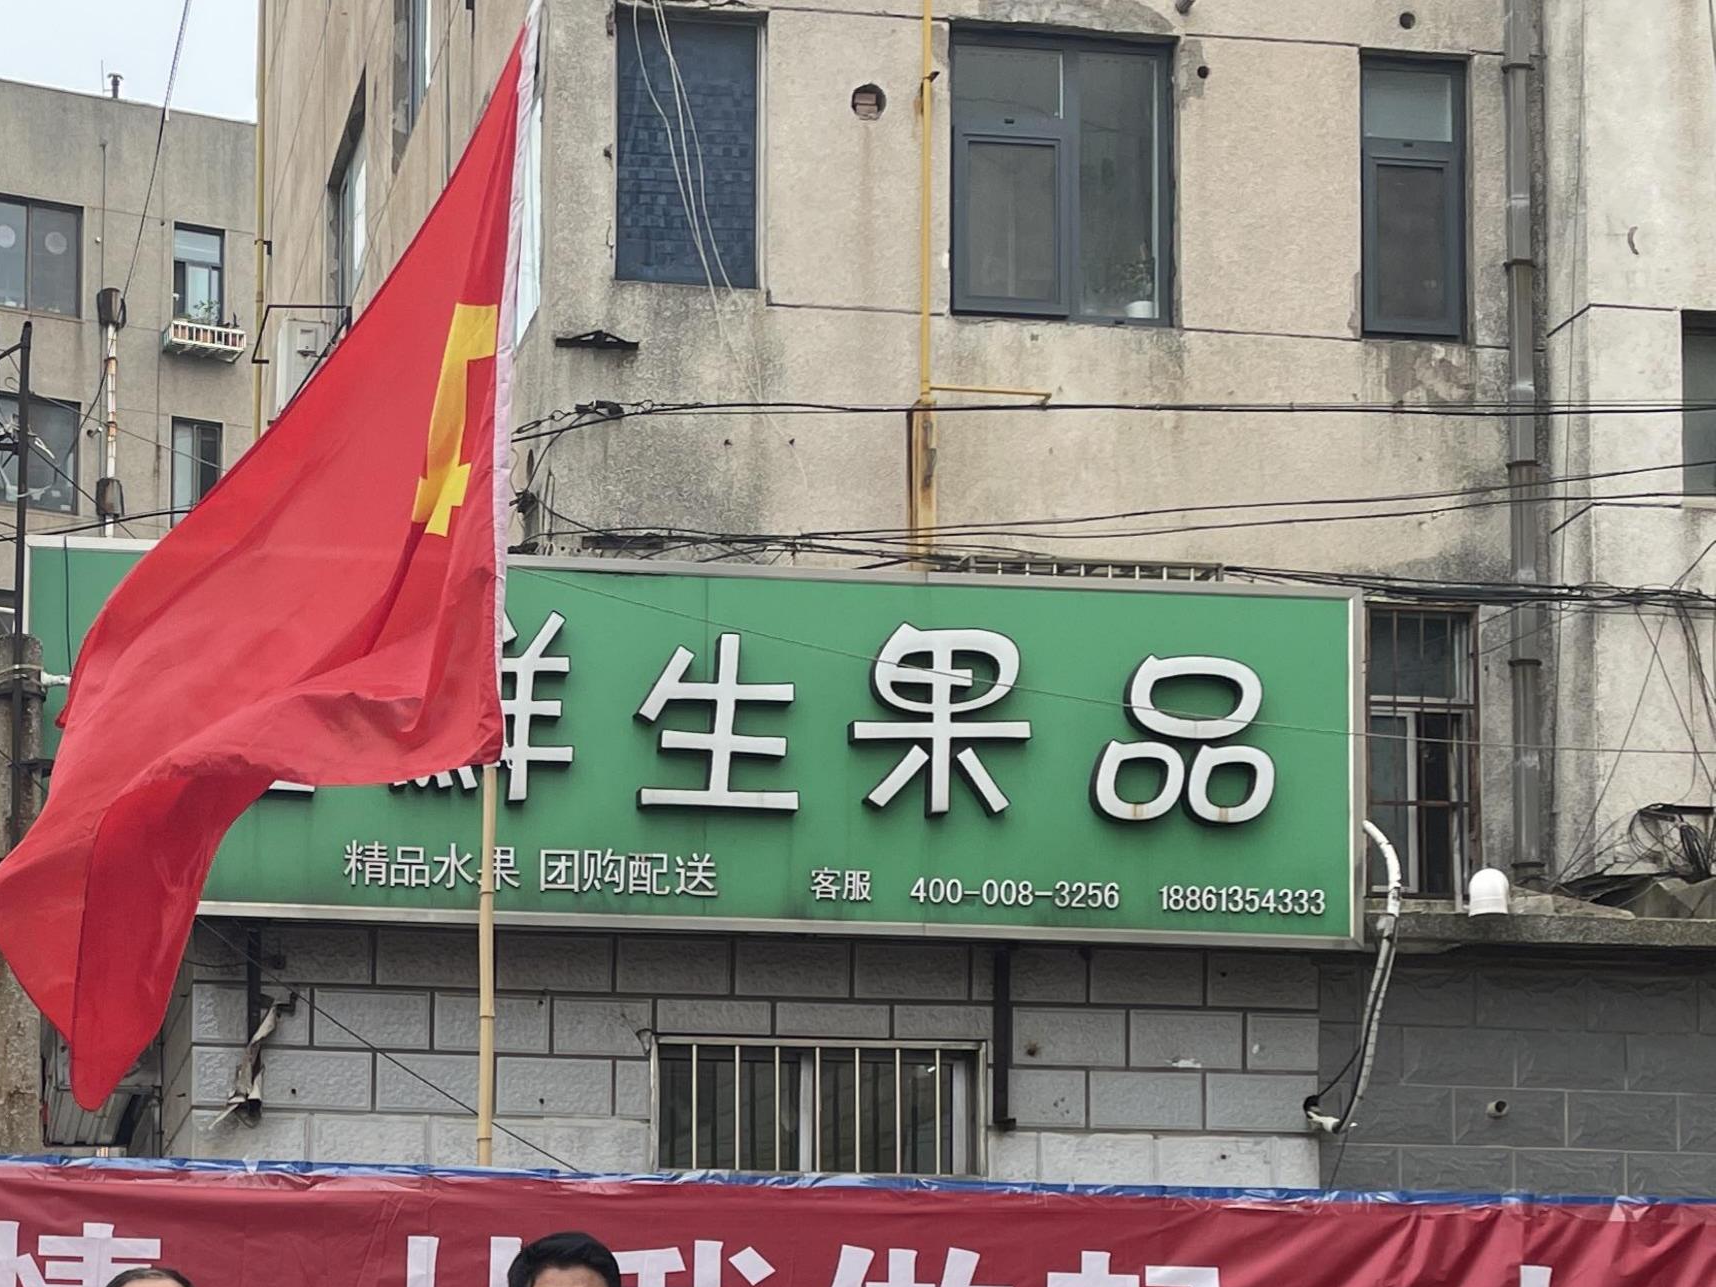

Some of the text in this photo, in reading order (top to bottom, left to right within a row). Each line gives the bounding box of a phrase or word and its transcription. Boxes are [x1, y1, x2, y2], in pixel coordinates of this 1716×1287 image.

[343, 838, 1327, 916] 精品水果 团购配送 客服 400-008-3256 18861354333
